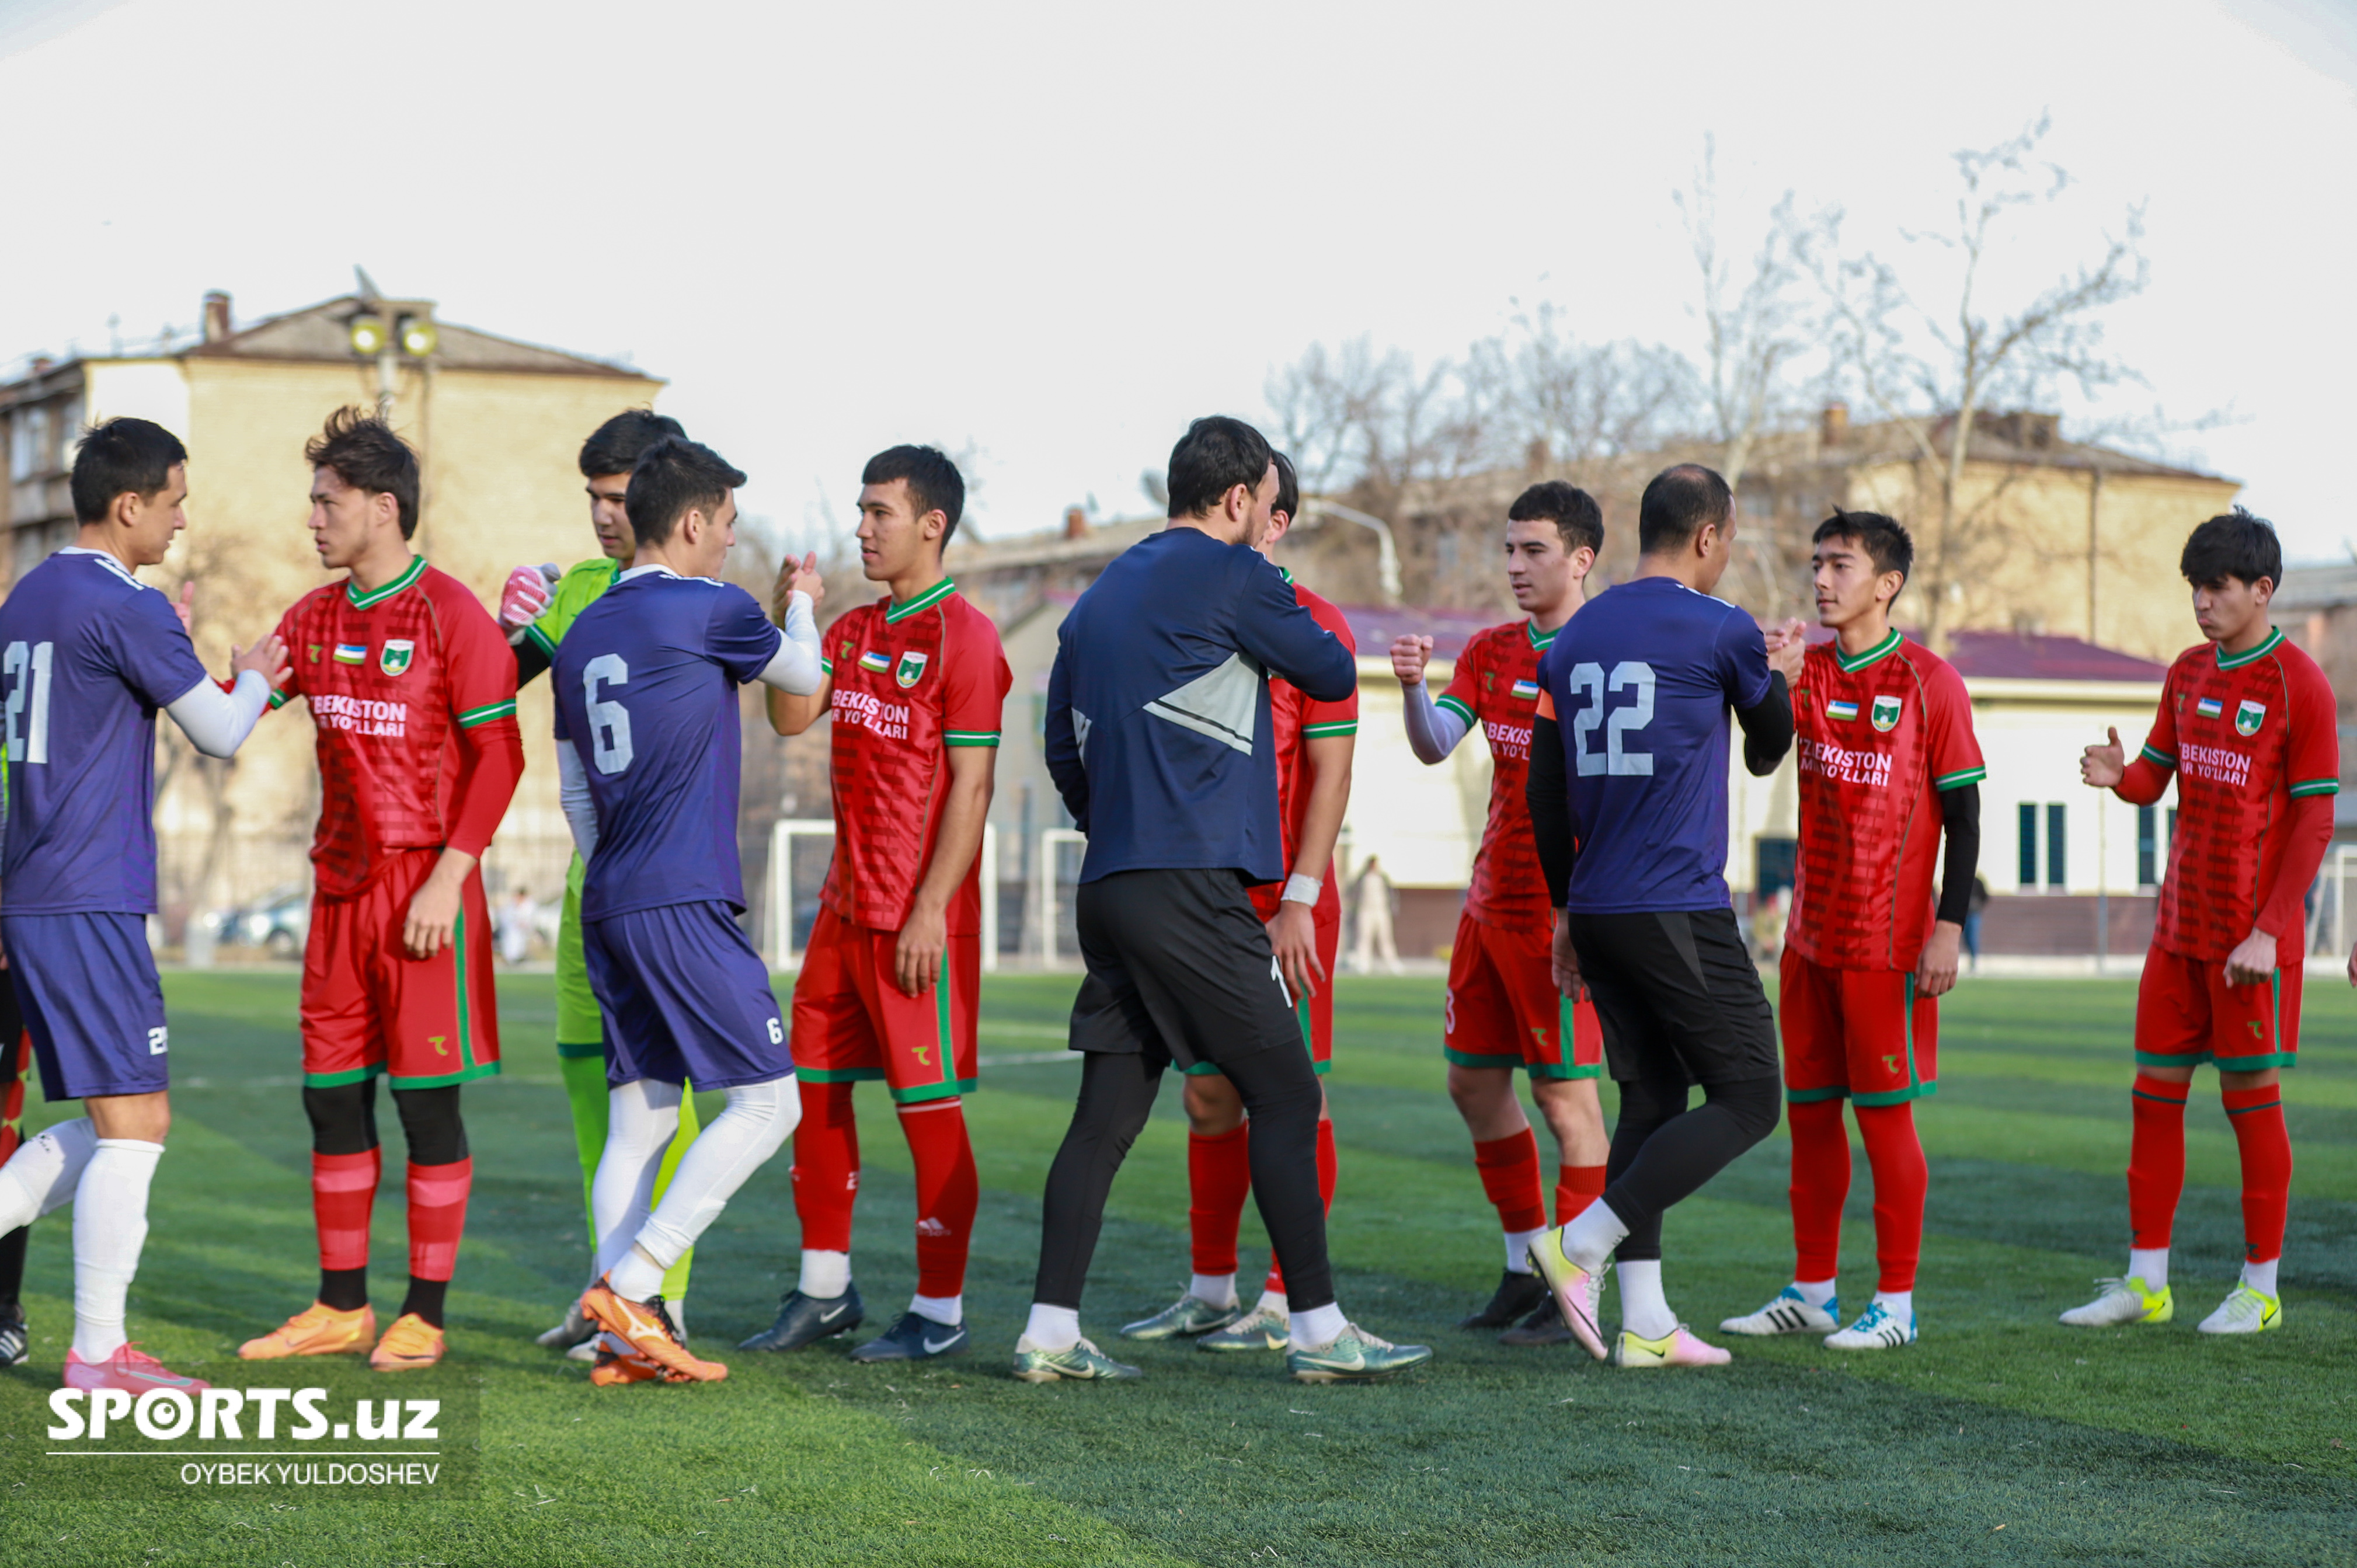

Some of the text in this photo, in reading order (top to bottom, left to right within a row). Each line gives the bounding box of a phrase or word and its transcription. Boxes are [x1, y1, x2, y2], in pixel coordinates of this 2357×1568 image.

[4, 640, 54, 764] 21
[309, 694, 407, 722] BEKISTON
[582, 653, 634, 775] 6
[831, 689, 910, 724] BEKISTON
[844, 709, 908, 740] YO'LLARI
[1483, 720, 1533, 746] BEKIS
[1569, 661, 1656, 777] 22
[1502, 743, 1530, 761] YO'L
[2178, 741, 2251, 773] BEKISTON
[766, 1017, 784, 1045] 6
